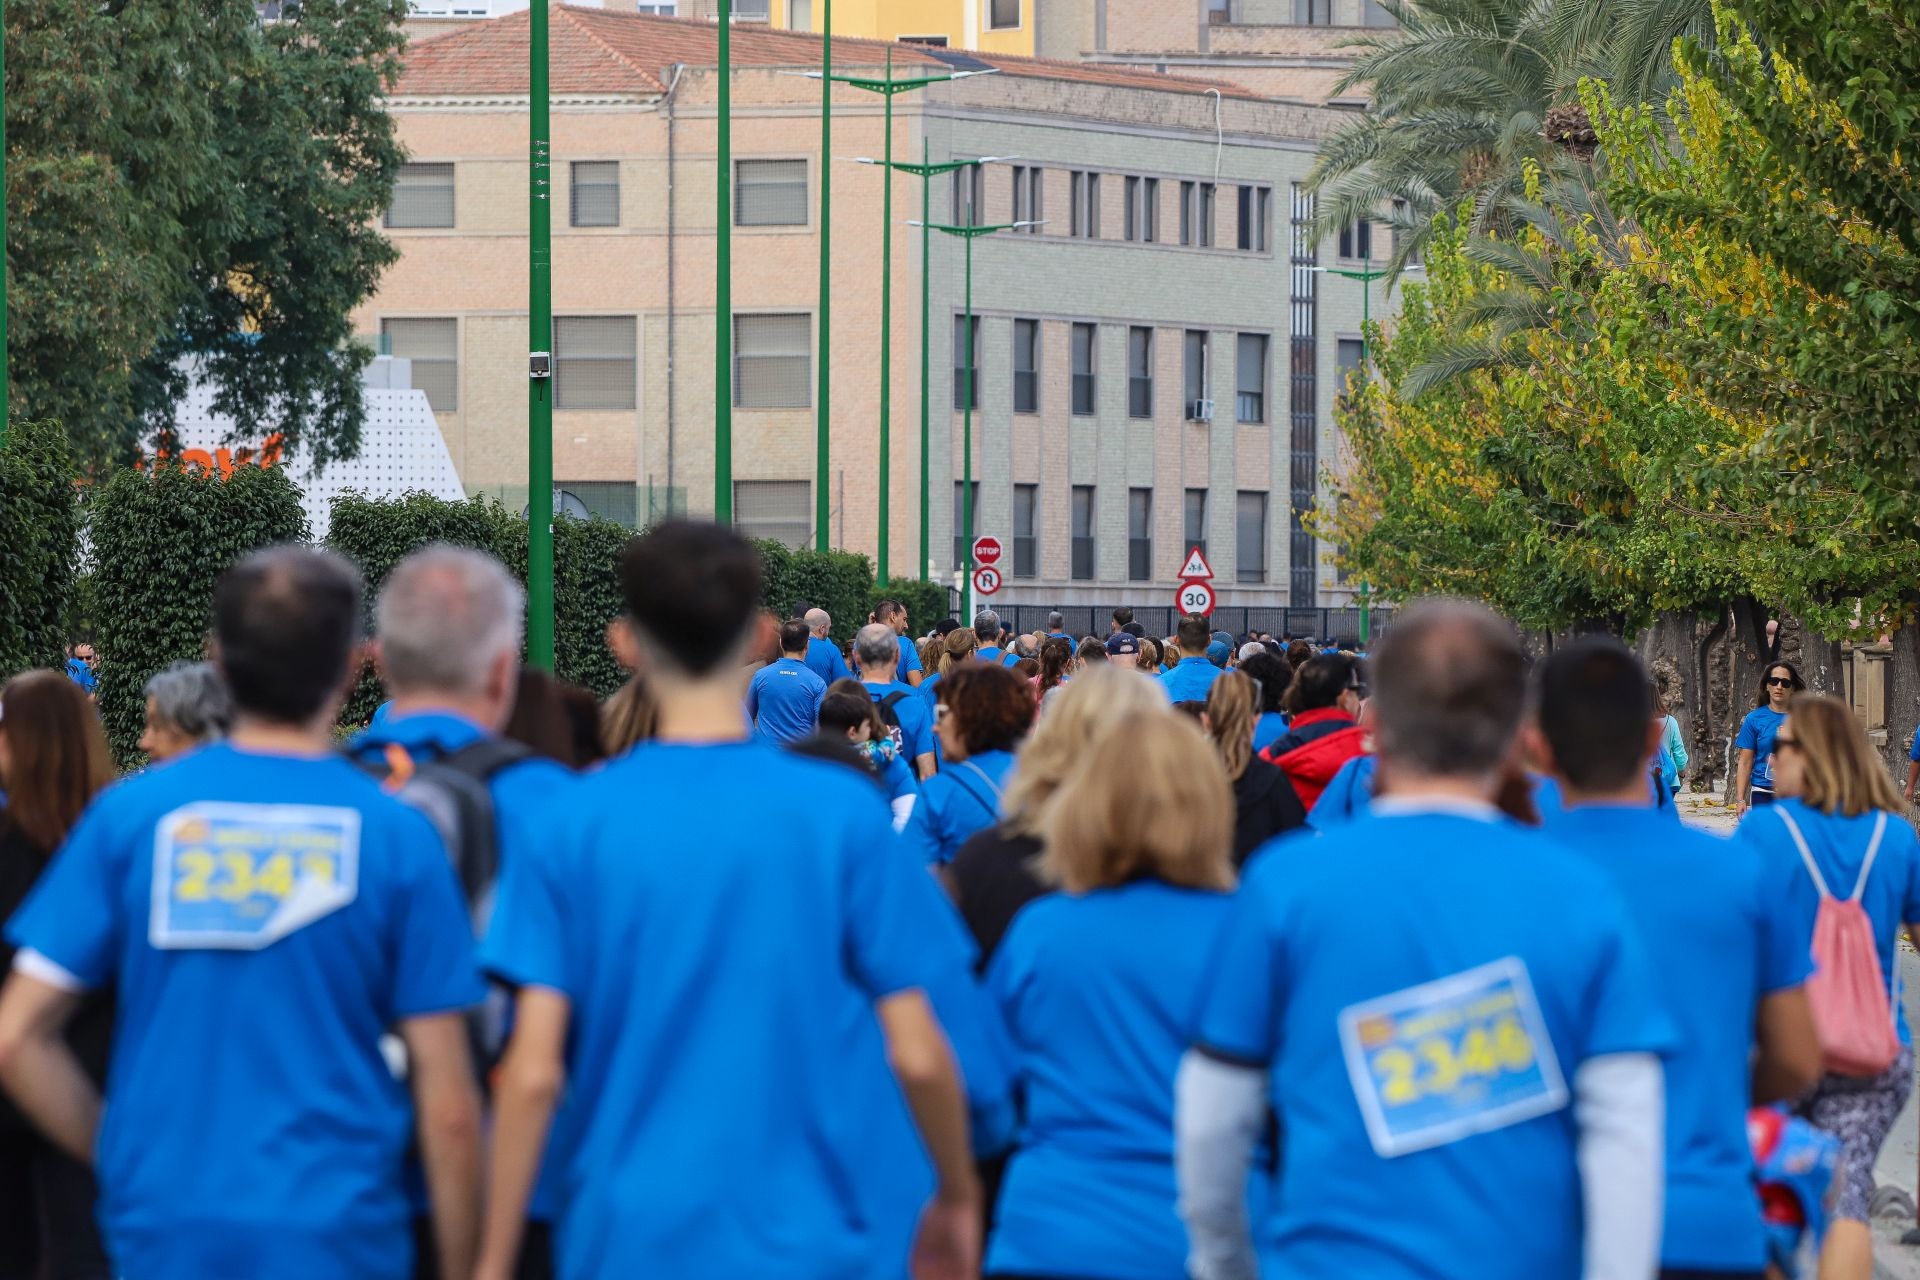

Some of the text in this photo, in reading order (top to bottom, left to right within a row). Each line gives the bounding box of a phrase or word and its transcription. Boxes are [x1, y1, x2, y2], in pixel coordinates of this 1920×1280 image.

[976, 546, 999, 555] STOP
[1185, 593, 1206, 606] 30
[1374, 1019, 1534, 1106] 2346
